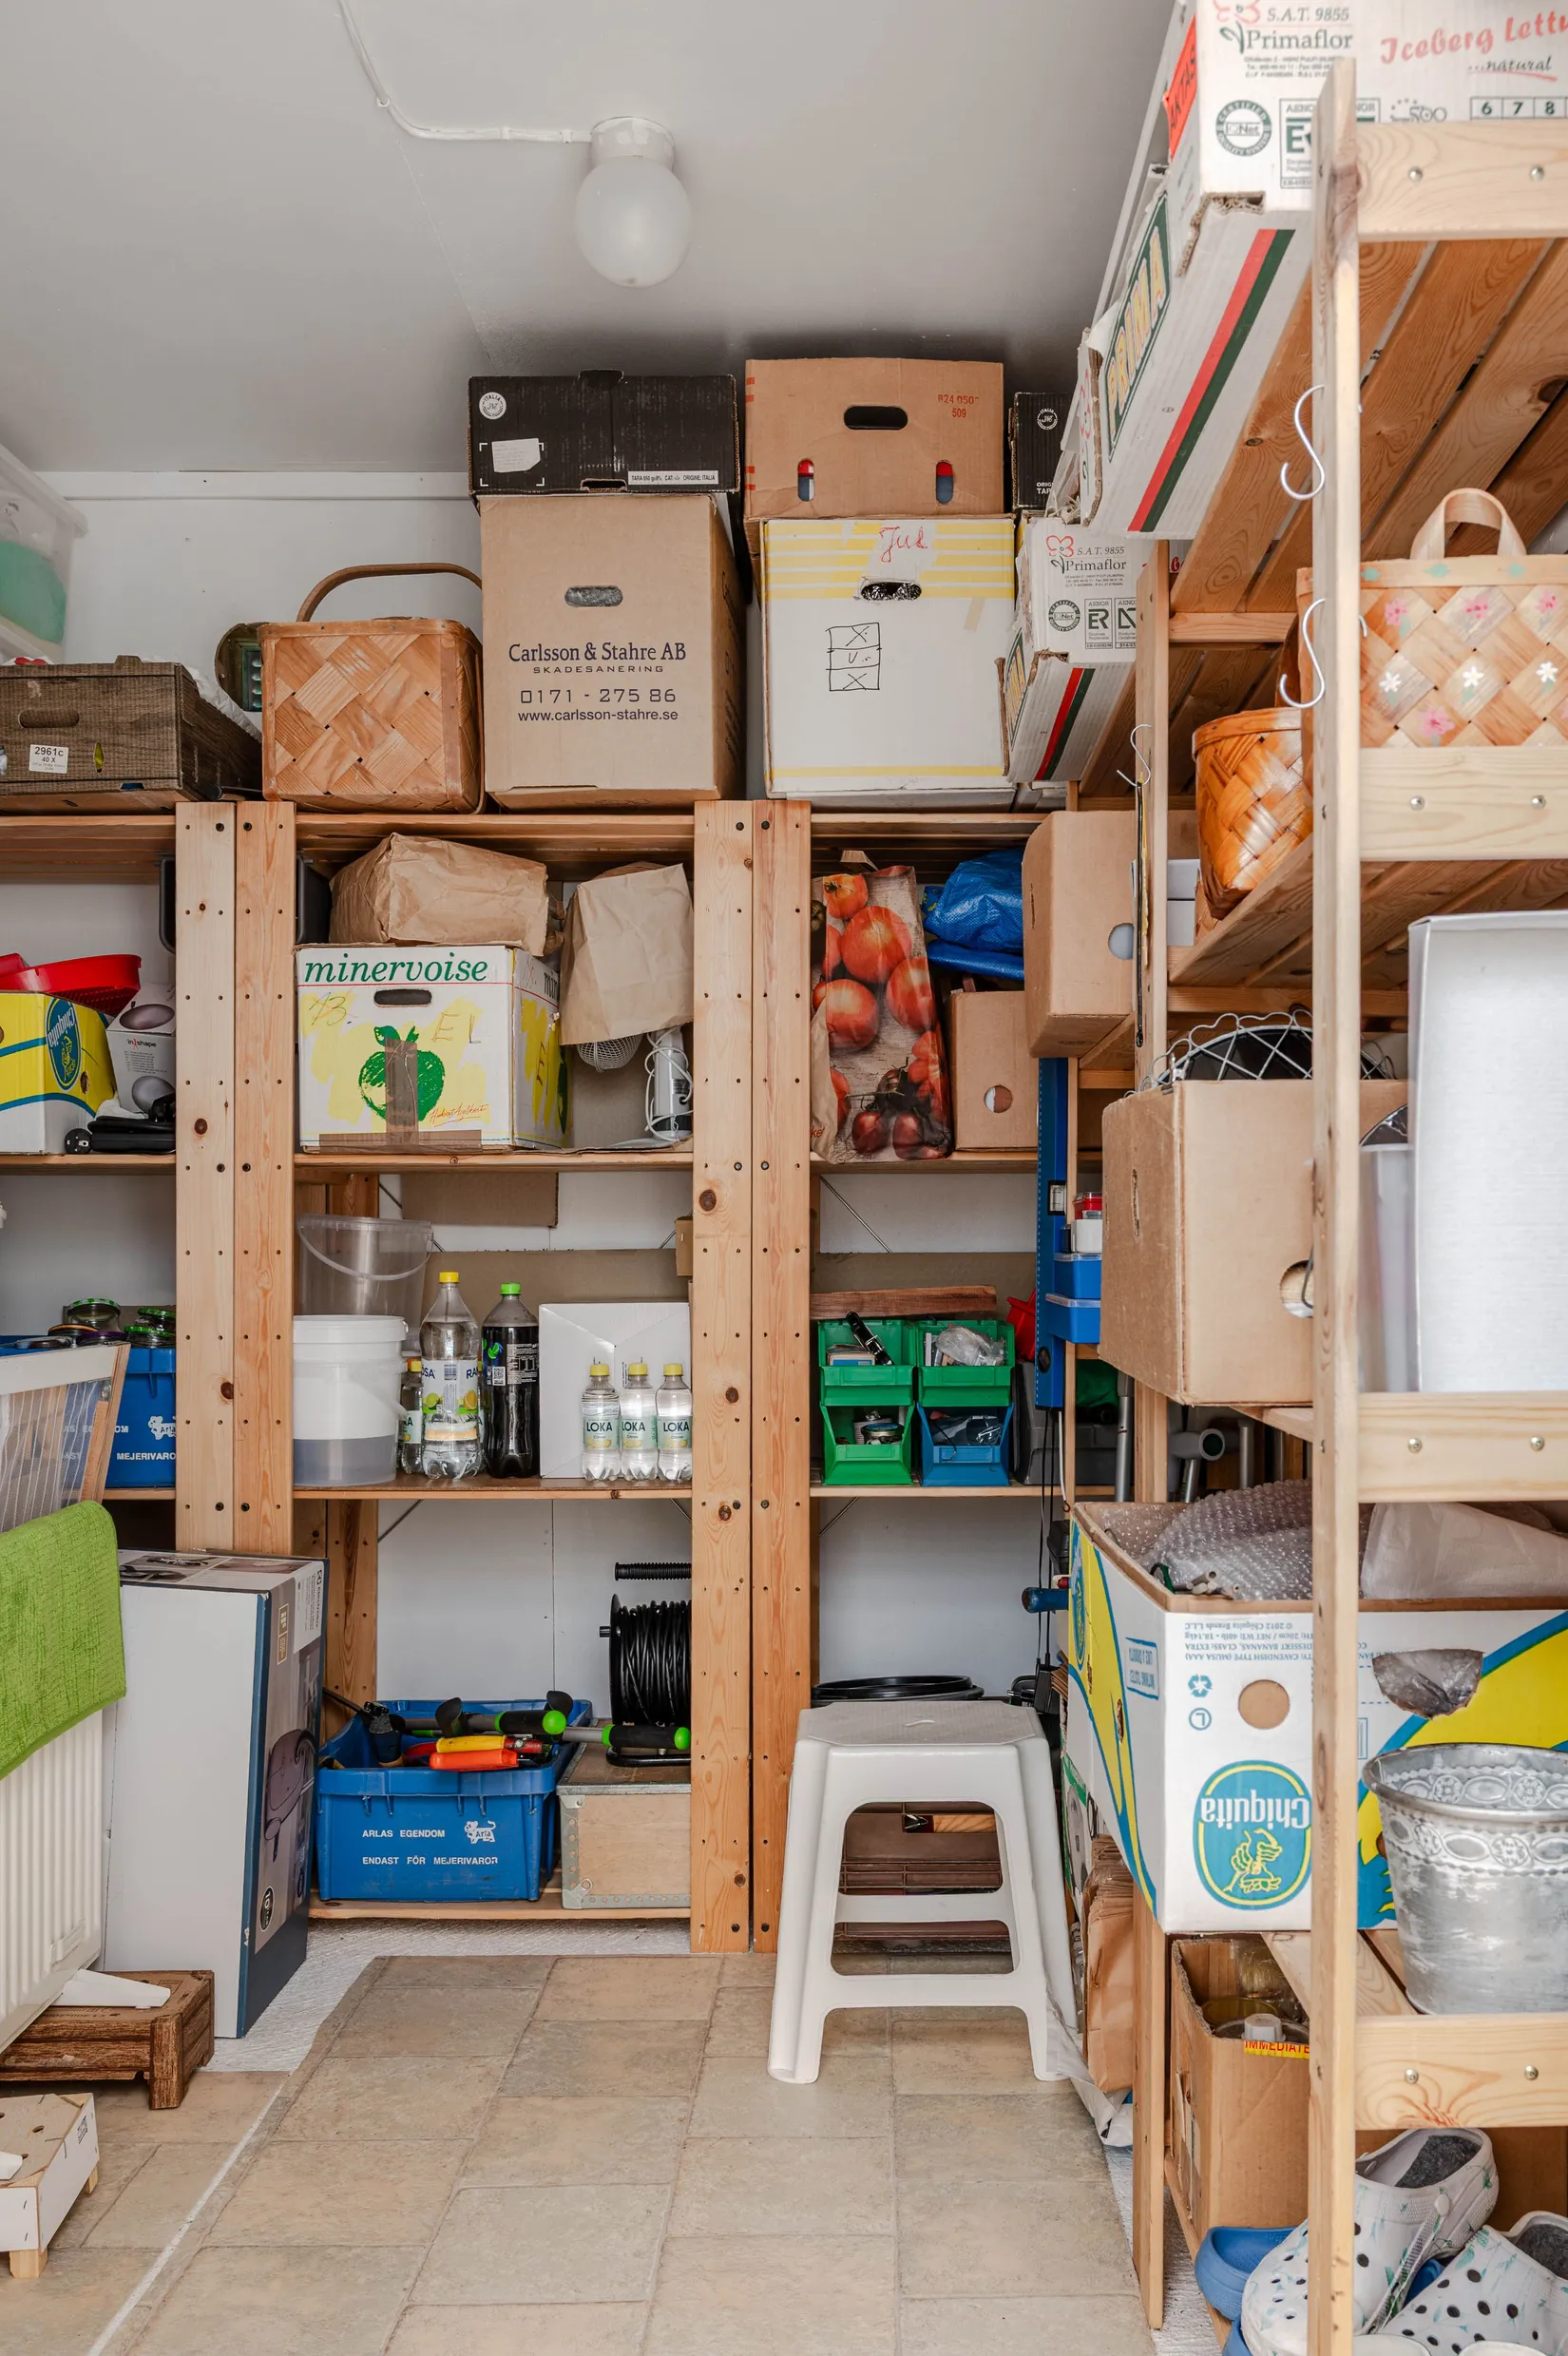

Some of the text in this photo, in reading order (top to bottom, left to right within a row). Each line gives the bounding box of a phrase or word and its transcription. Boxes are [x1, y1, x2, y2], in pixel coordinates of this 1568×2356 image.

[1267, 7, 1349, 22] S.A.T. 9855
[1246, 29, 1353, 49] Primaflor
[1381, 28, 1494, 64] Iceberg
[1286, 104, 1313, 113] AENO
[1482, 102, 1493, 116] 6
[1513, 102, 1524, 116] 7
[1544, 102, 1556, 116] 8
[1107, 225, 1167, 435] PRIMA
[951, 408, 967, 418] 509
[1077, 546, 1125, 556] S.A.T. 9855
[1065, 559, 1127, 571] Primaflor
[508, 642, 686, 662] Carlsson & Stahre AB
[533, 665, 663, 674] SKADESANERING
[520, 689, 572, 704] 0171
[600, 688, 640, 703] 275
[649, 688, 677, 702] 86
[518, 709, 679, 721] www.carlsson-stahre.se
[304, 951, 488, 983] minervoise
[47, 1006, 76, 1048] Chiquita
[586, 1422, 613, 1432] LOKA
[622, 1422, 646, 1431] LOKA
[663, 1422, 690, 1432] LOKA
[116, 1452, 176, 1461] MEJERIVARO
[1232, 1620, 1264, 1630] Chiquita
[1184, 1642, 1210, 1651] EXTRA
[1281, 1642, 1312, 1651] DESSERT
[1185, 1653, 1207, 1661] AAA)
[1208, 1653, 1233, 1661] (MUSA
[1233, 1653, 1252, 1661] TYPE
[1253, 1653, 1300, 1661] CAVENDISH
[1200, 1789, 1310, 1829] Chiquita
[362, 1829, 446, 1838] ARLAS EGENDOM
[362, 1855, 498, 1865] ENDAST FÖR MEJERIVAROR
